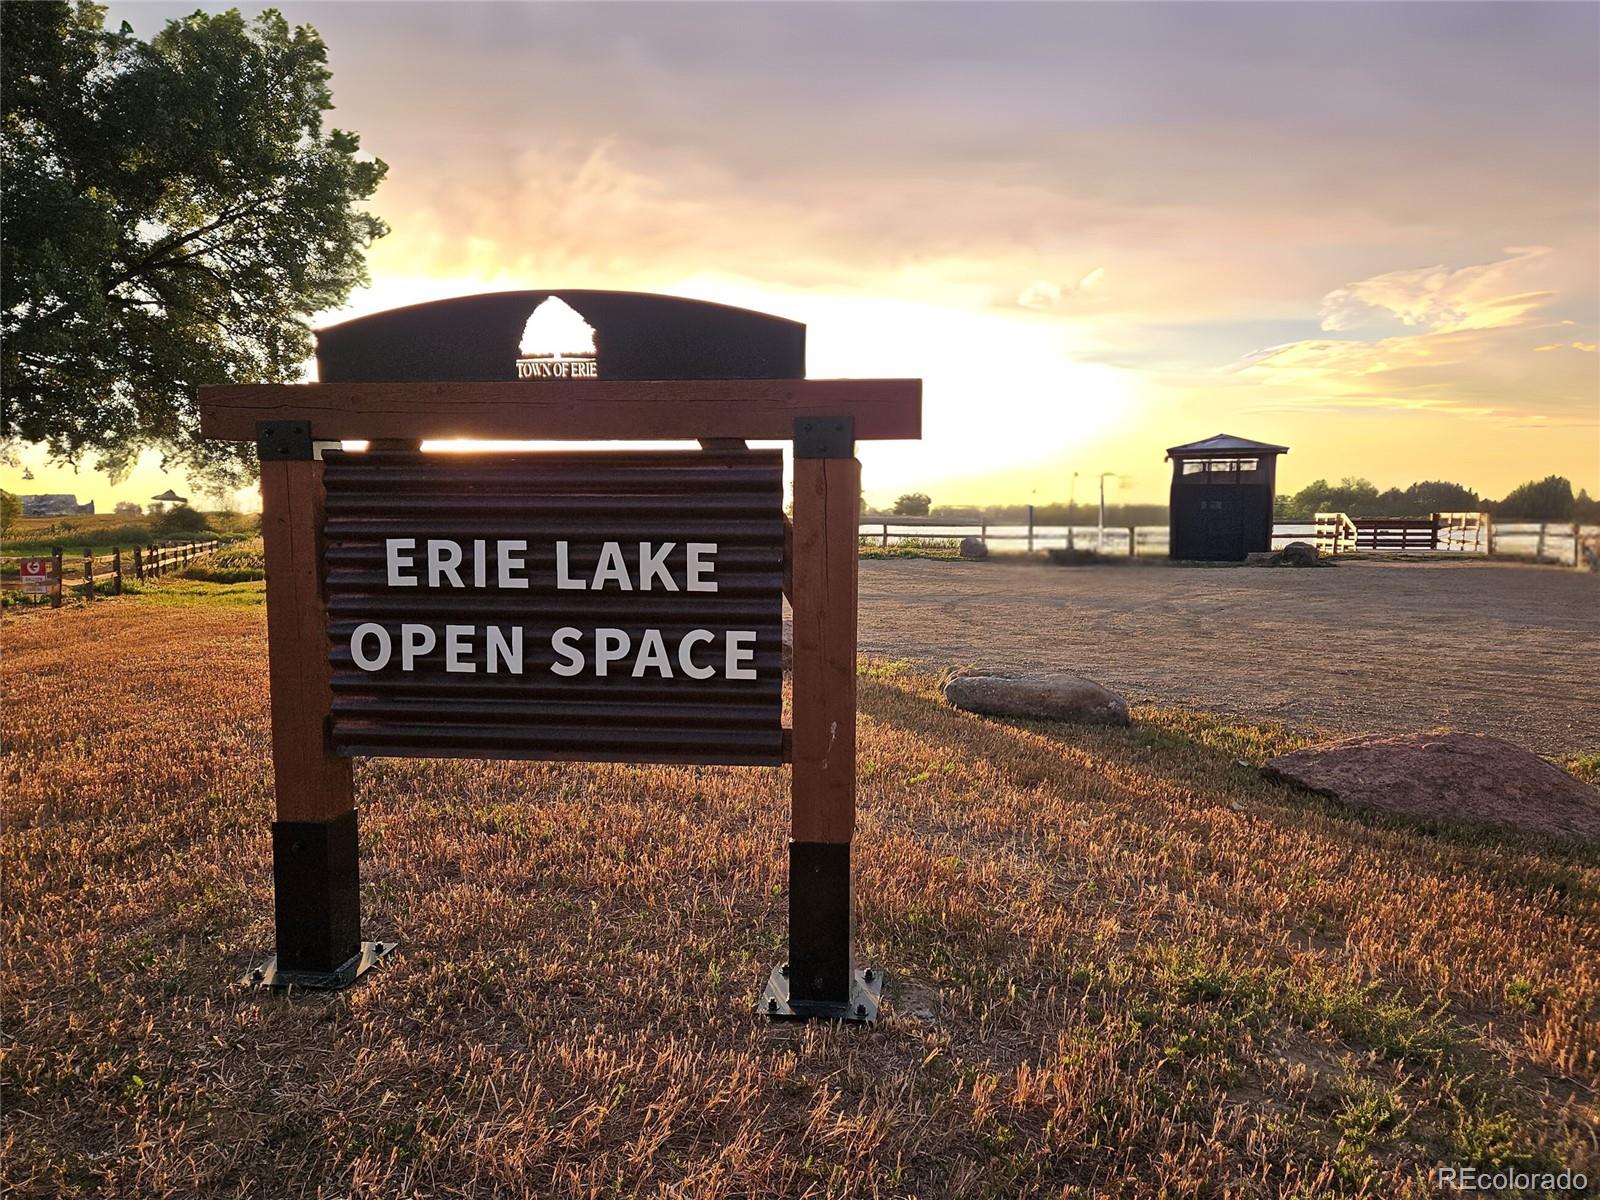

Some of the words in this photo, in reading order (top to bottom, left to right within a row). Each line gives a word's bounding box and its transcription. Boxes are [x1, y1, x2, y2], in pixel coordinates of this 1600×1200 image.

[516, 362, 551, 378] TOWN
[553, 362, 569, 378] OF
[571, 362, 598, 377] ERIE
[386, 538, 529, 589] ERIE
[556, 540, 719, 592] LAKE
[350, 622, 524, 675] OPEN
[550, 626, 758, 680] SPACE
